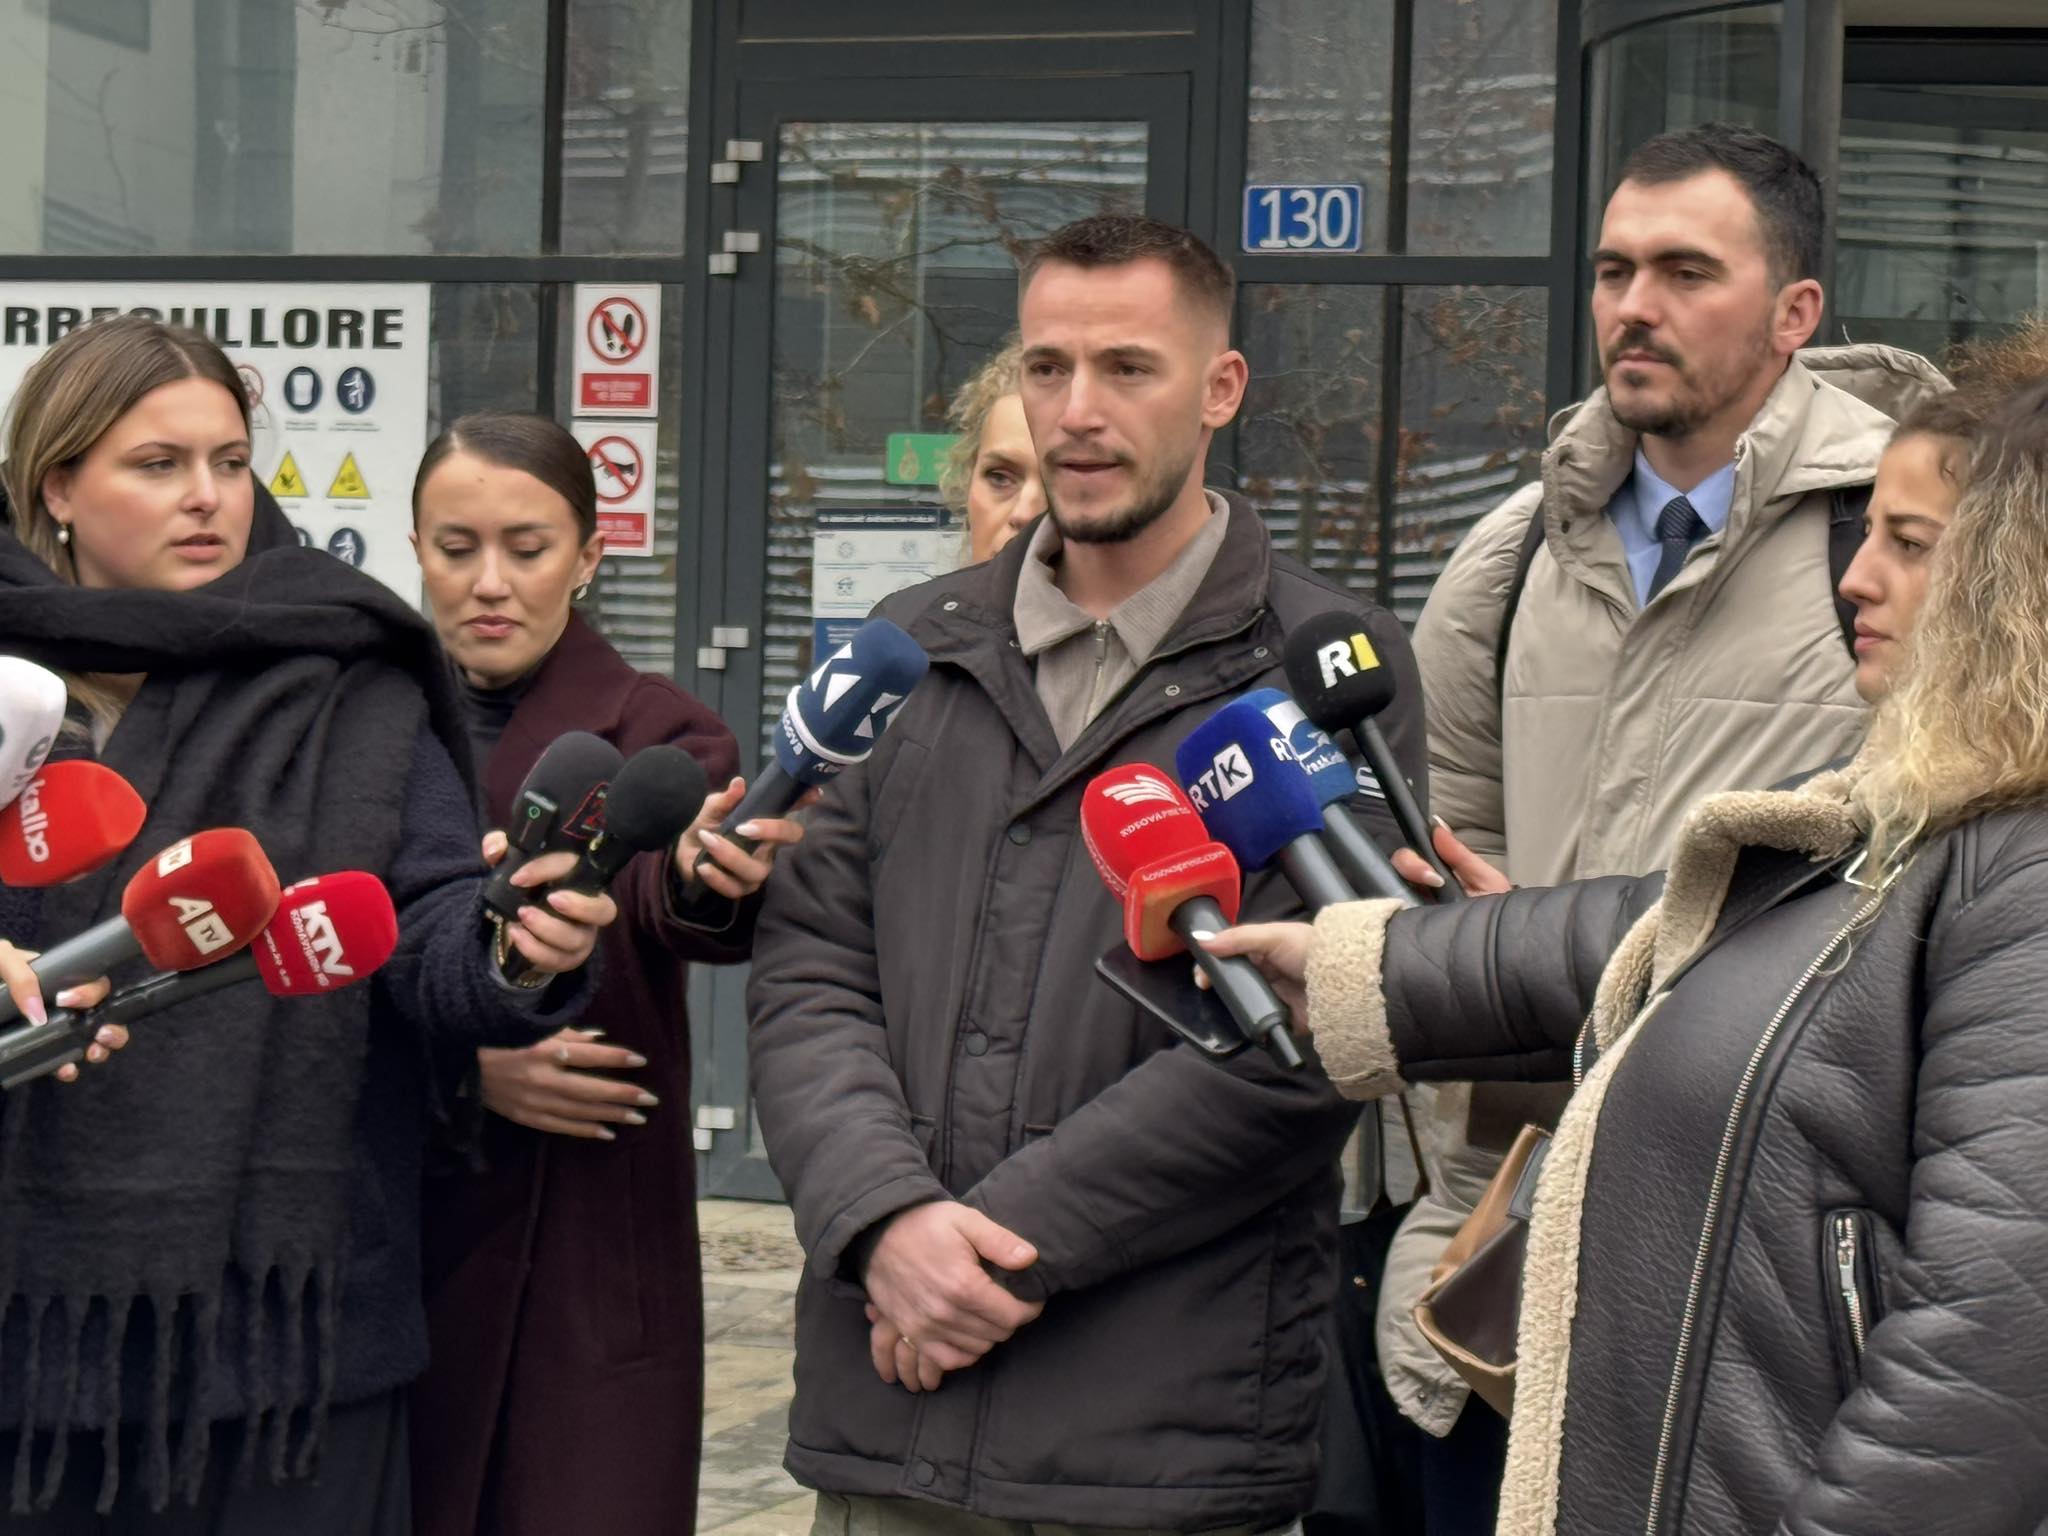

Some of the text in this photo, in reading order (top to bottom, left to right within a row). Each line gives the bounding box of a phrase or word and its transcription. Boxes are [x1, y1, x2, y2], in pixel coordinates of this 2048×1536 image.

[1259, 189, 1352, 249] 130
[1188, 744, 1250, 813] RTK
[300, 900, 354, 976] KTV
